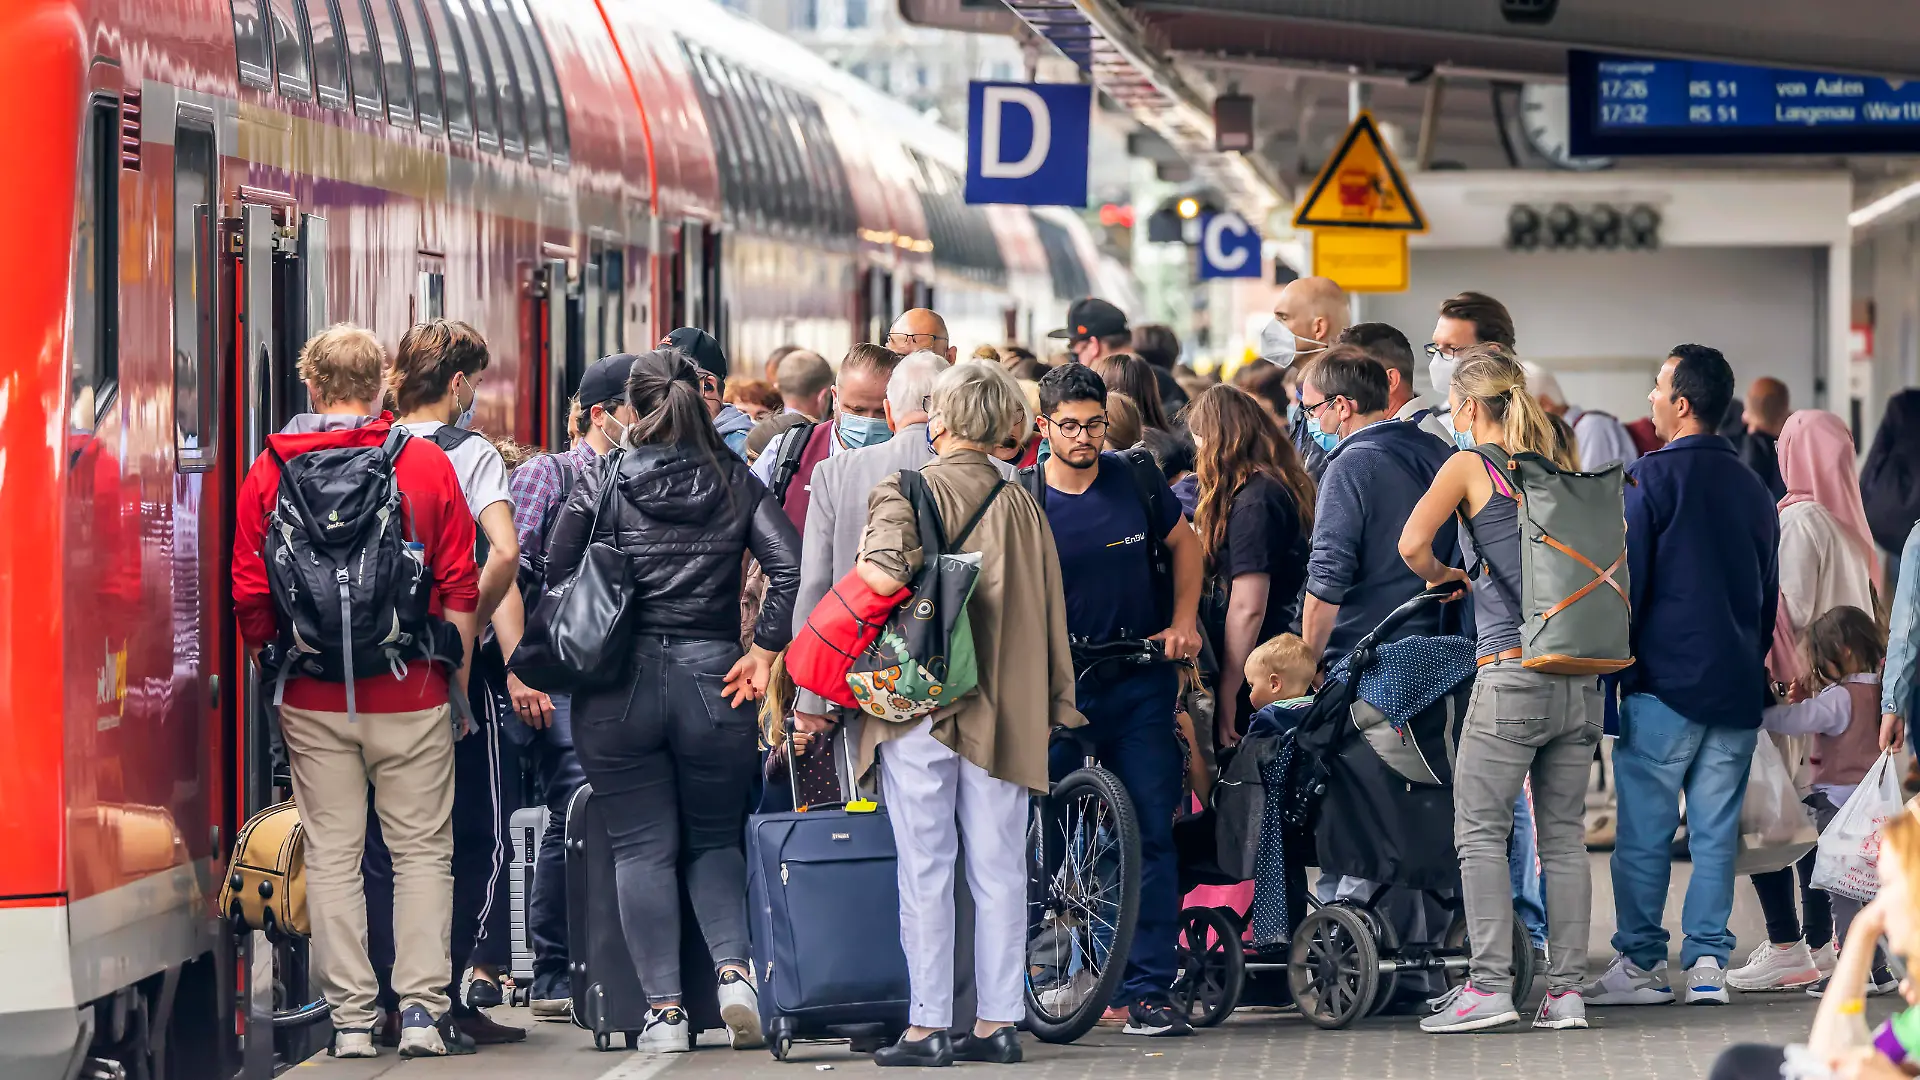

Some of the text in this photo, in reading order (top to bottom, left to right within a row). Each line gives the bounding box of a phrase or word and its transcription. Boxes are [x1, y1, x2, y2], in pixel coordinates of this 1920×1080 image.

[1602, 78, 1864, 98] 17:26 RS 51 von Aalen
[981, 86, 1051, 179] D
[1602, 104, 1648, 122] 17:32
[1690, 105, 1711, 122] RS
[1717, 105, 1737, 122] 51
[1776, 103, 1855, 126] Langenau
[1204, 212, 1248, 271] C
